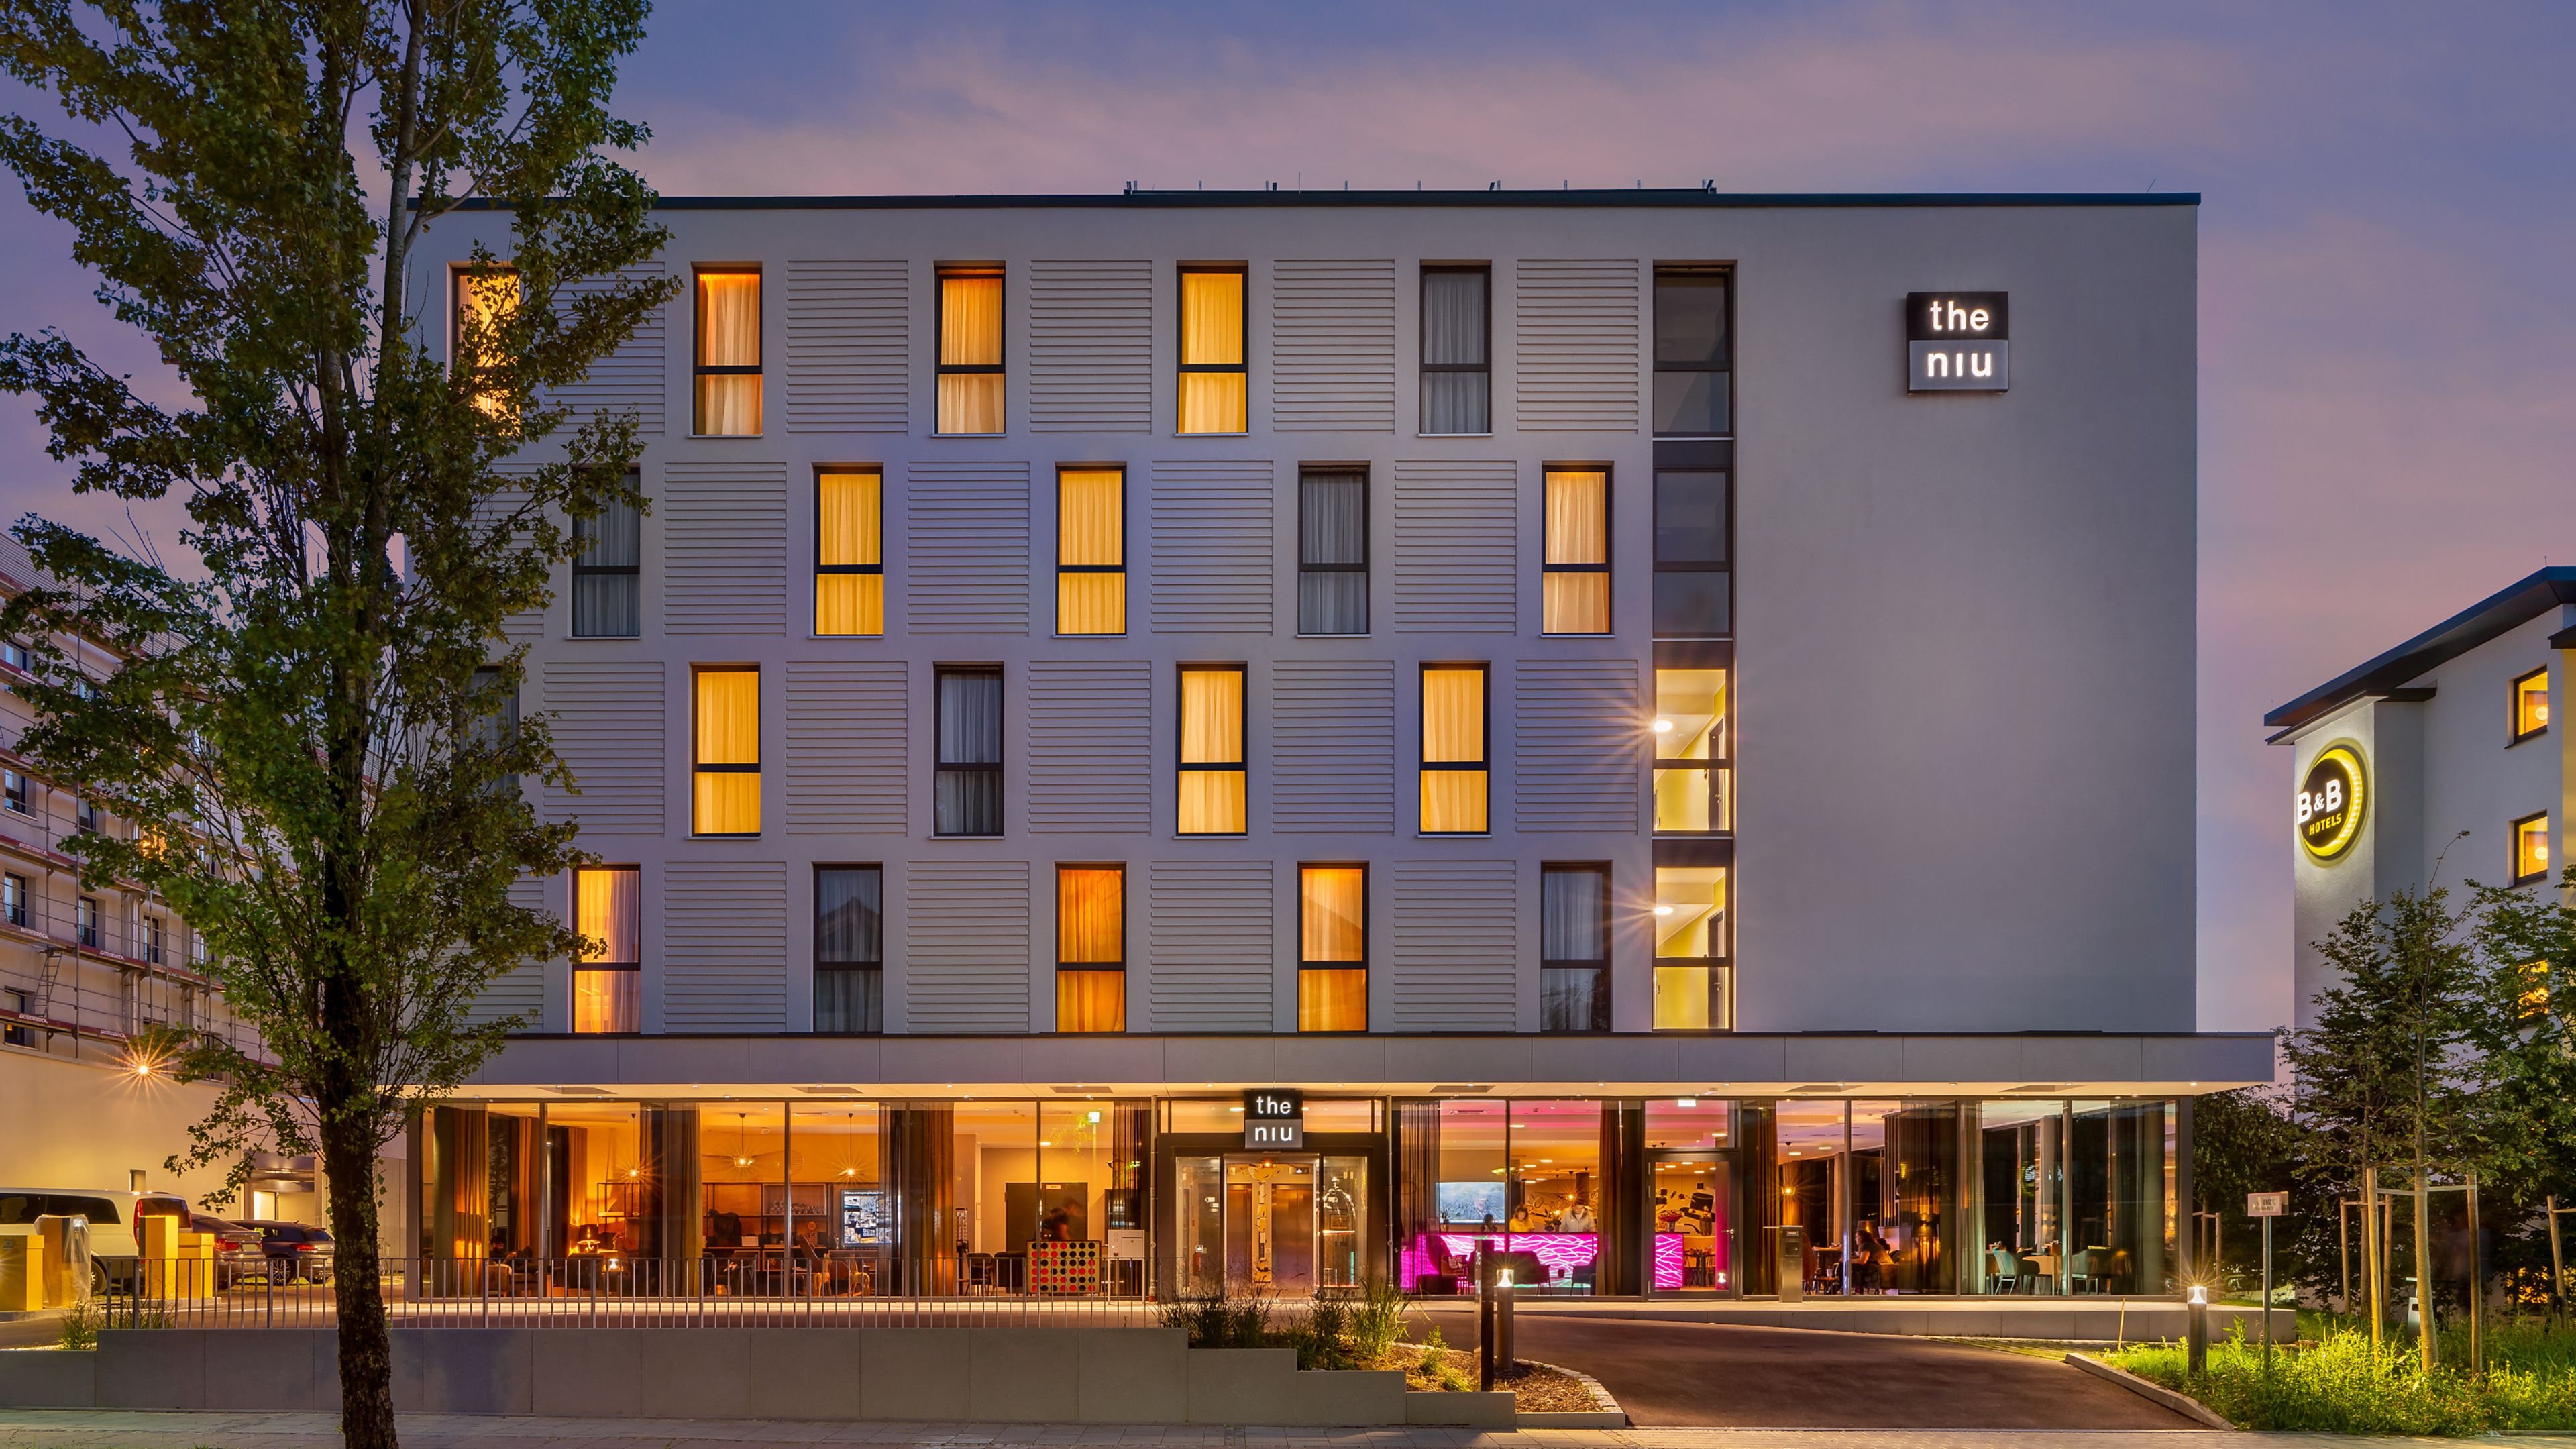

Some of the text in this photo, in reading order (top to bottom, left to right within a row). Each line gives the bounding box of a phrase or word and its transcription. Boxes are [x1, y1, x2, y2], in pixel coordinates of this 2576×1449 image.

[1929, 300, 1990, 331] the
[1927, 352, 1992, 378] niu
[2297, 779, 2342, 824] B&B
[2309, 812, 2342, 836] HOTELS
[1256, 1095, 1291, 1114] the
[1254, 1126, 1293, 1142] niu
